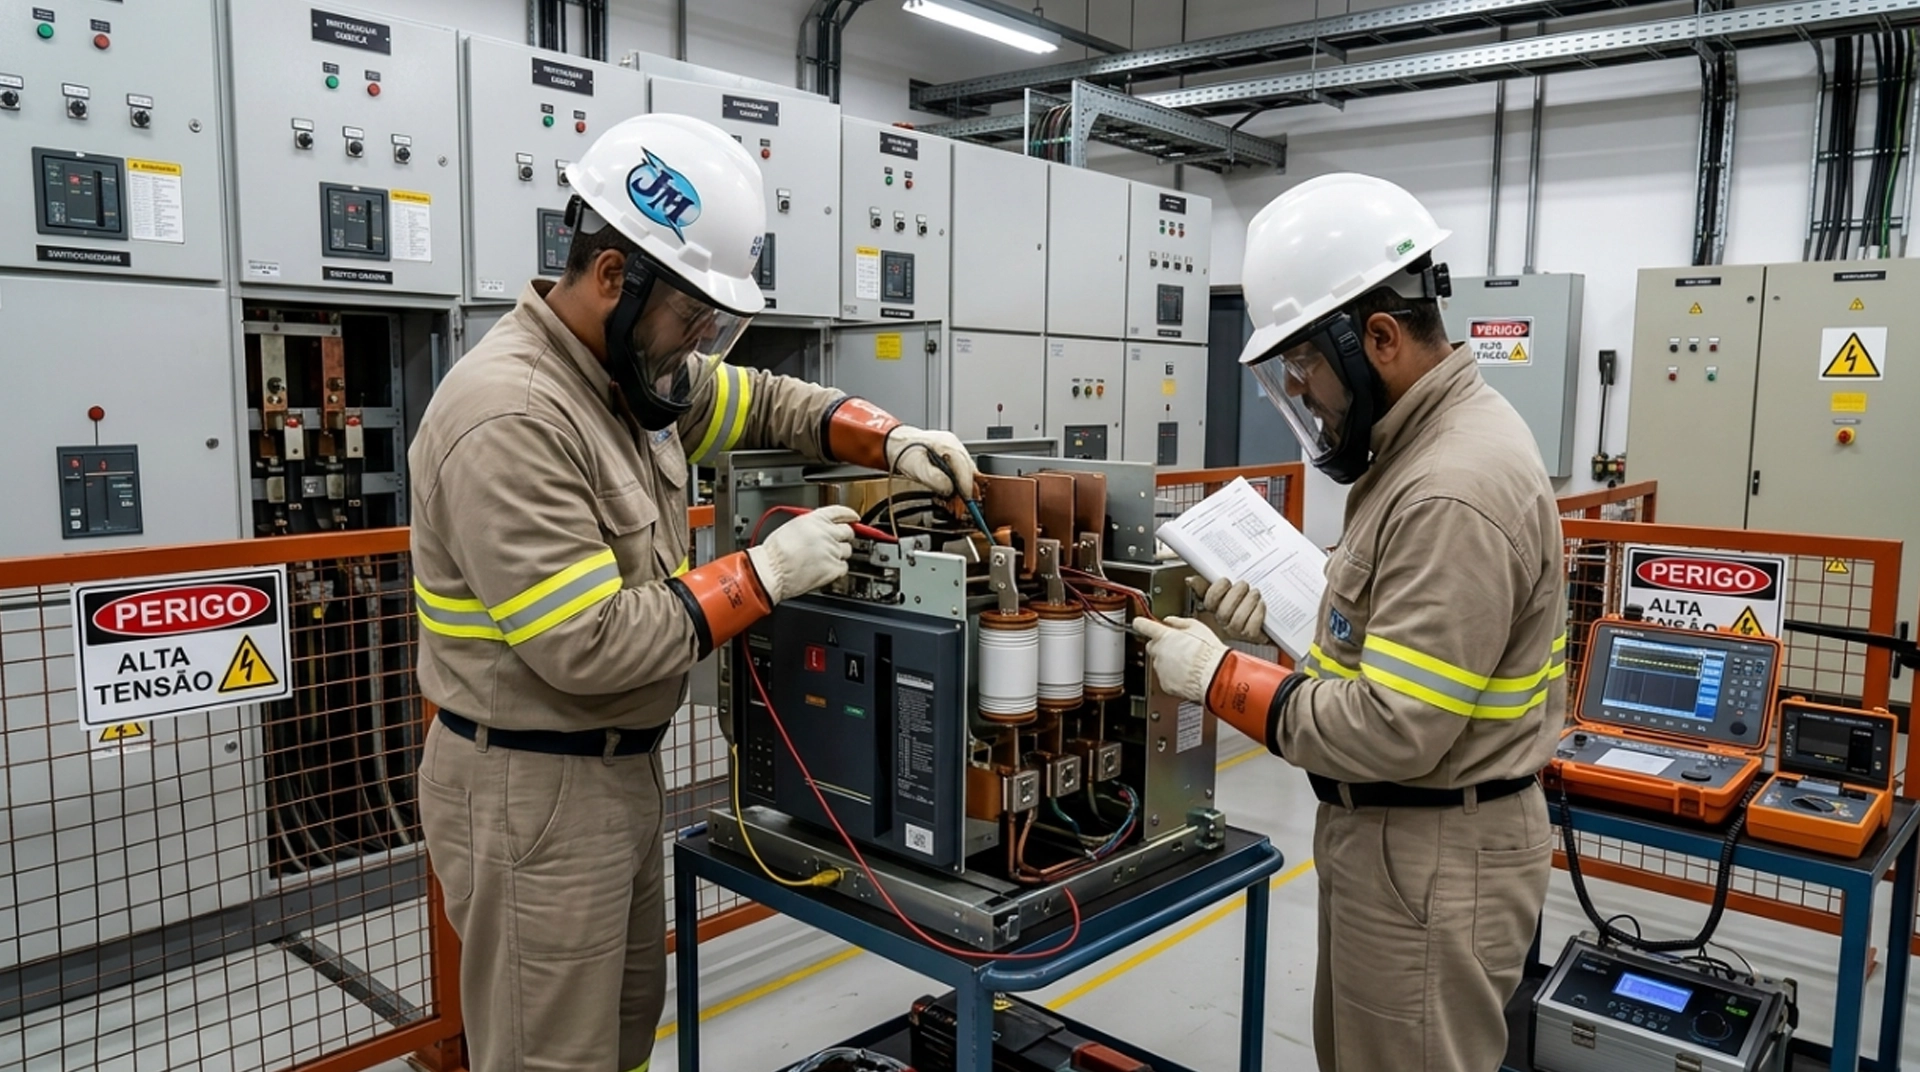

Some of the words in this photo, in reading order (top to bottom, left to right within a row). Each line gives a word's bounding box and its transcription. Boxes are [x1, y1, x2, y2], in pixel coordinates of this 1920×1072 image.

[631, 169, 695, 225] JM
[1650, 562, 1756, 589] PERIGO
[115, 591, 252, 630] PERIGO
[1648, 597, 1703, 617] ALTA
[117, 646, 191, 675] ALTA
[93, 669, 214, 706] TENSÃO
